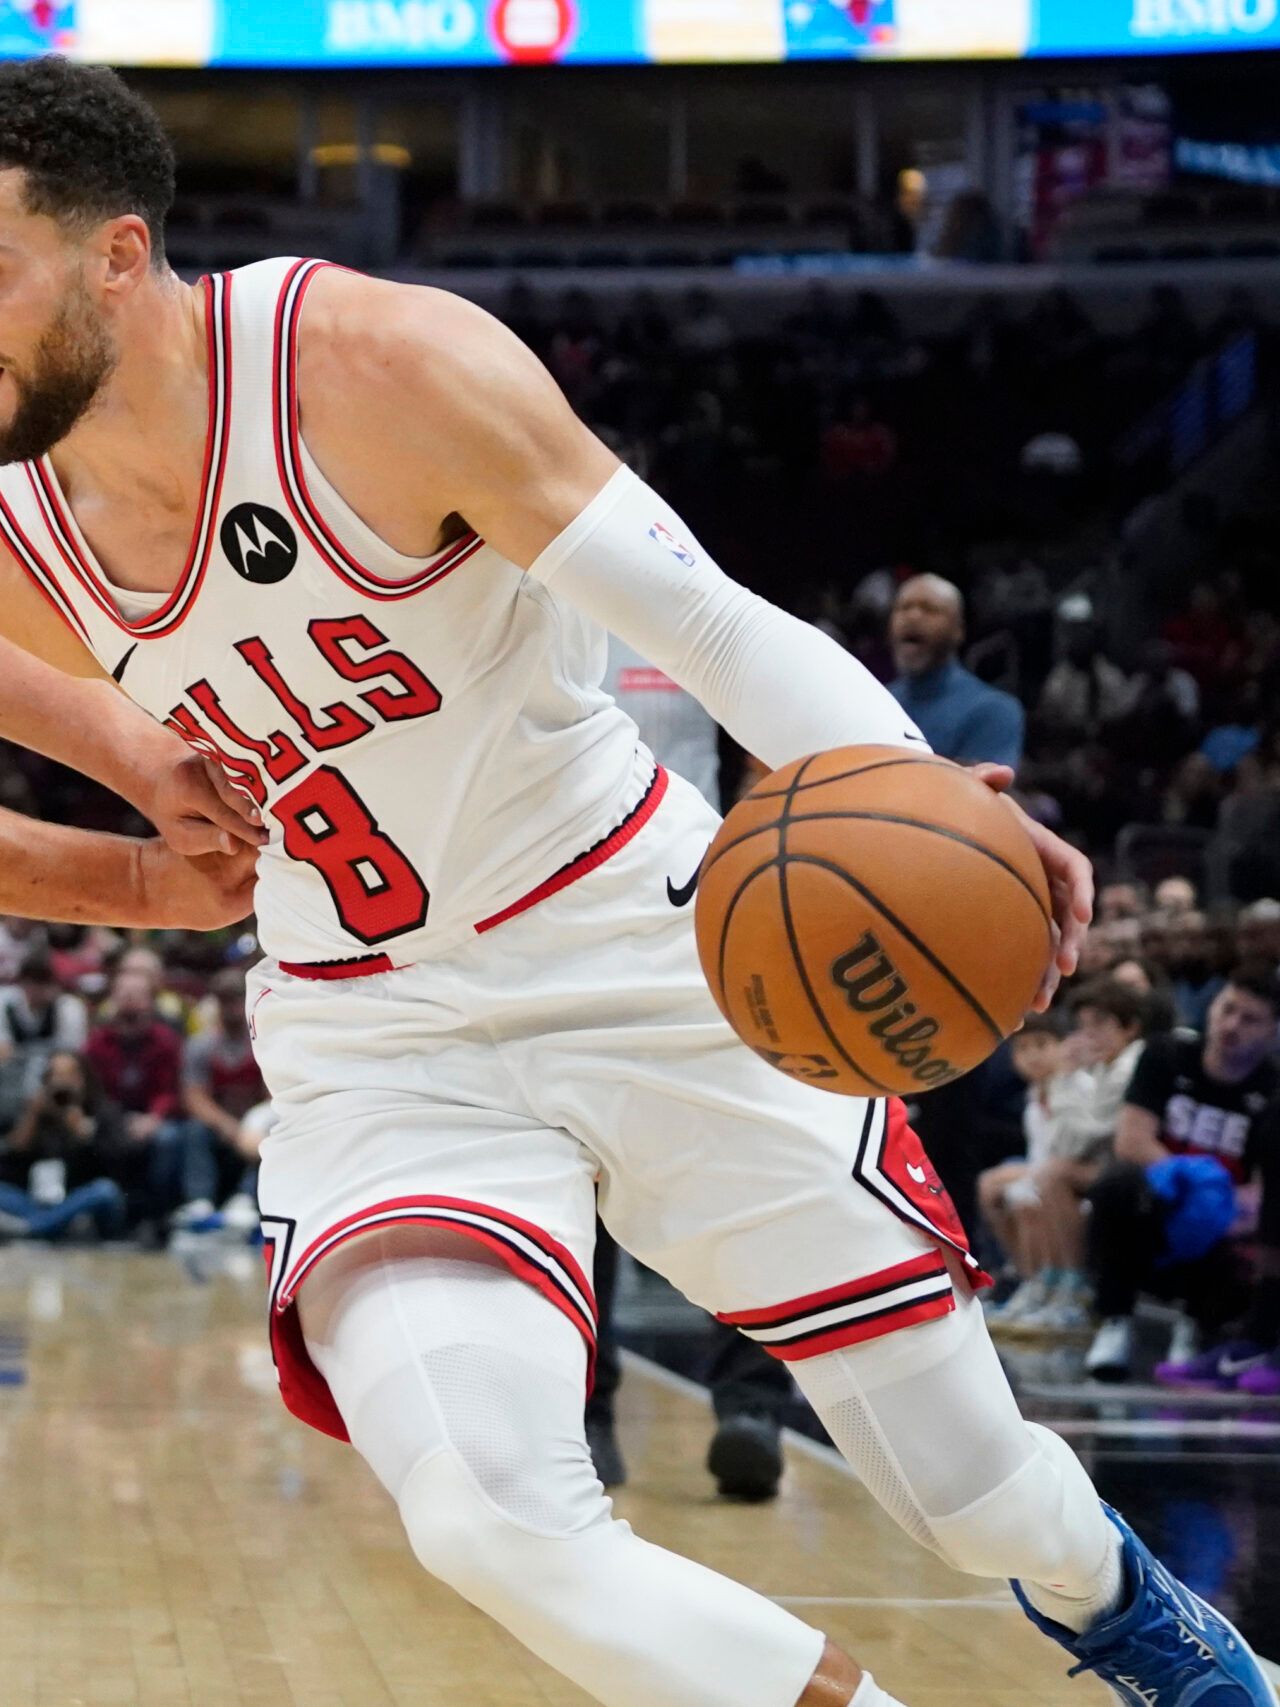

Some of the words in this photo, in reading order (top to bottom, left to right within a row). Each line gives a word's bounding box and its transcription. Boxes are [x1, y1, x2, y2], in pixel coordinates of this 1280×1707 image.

[324, 0, 476, 50] BMO
[1128, 0, 1279, 38] BMO
[268, 763, 431, 947] 8
[1165, 1093, 1250, 1157] SEE
